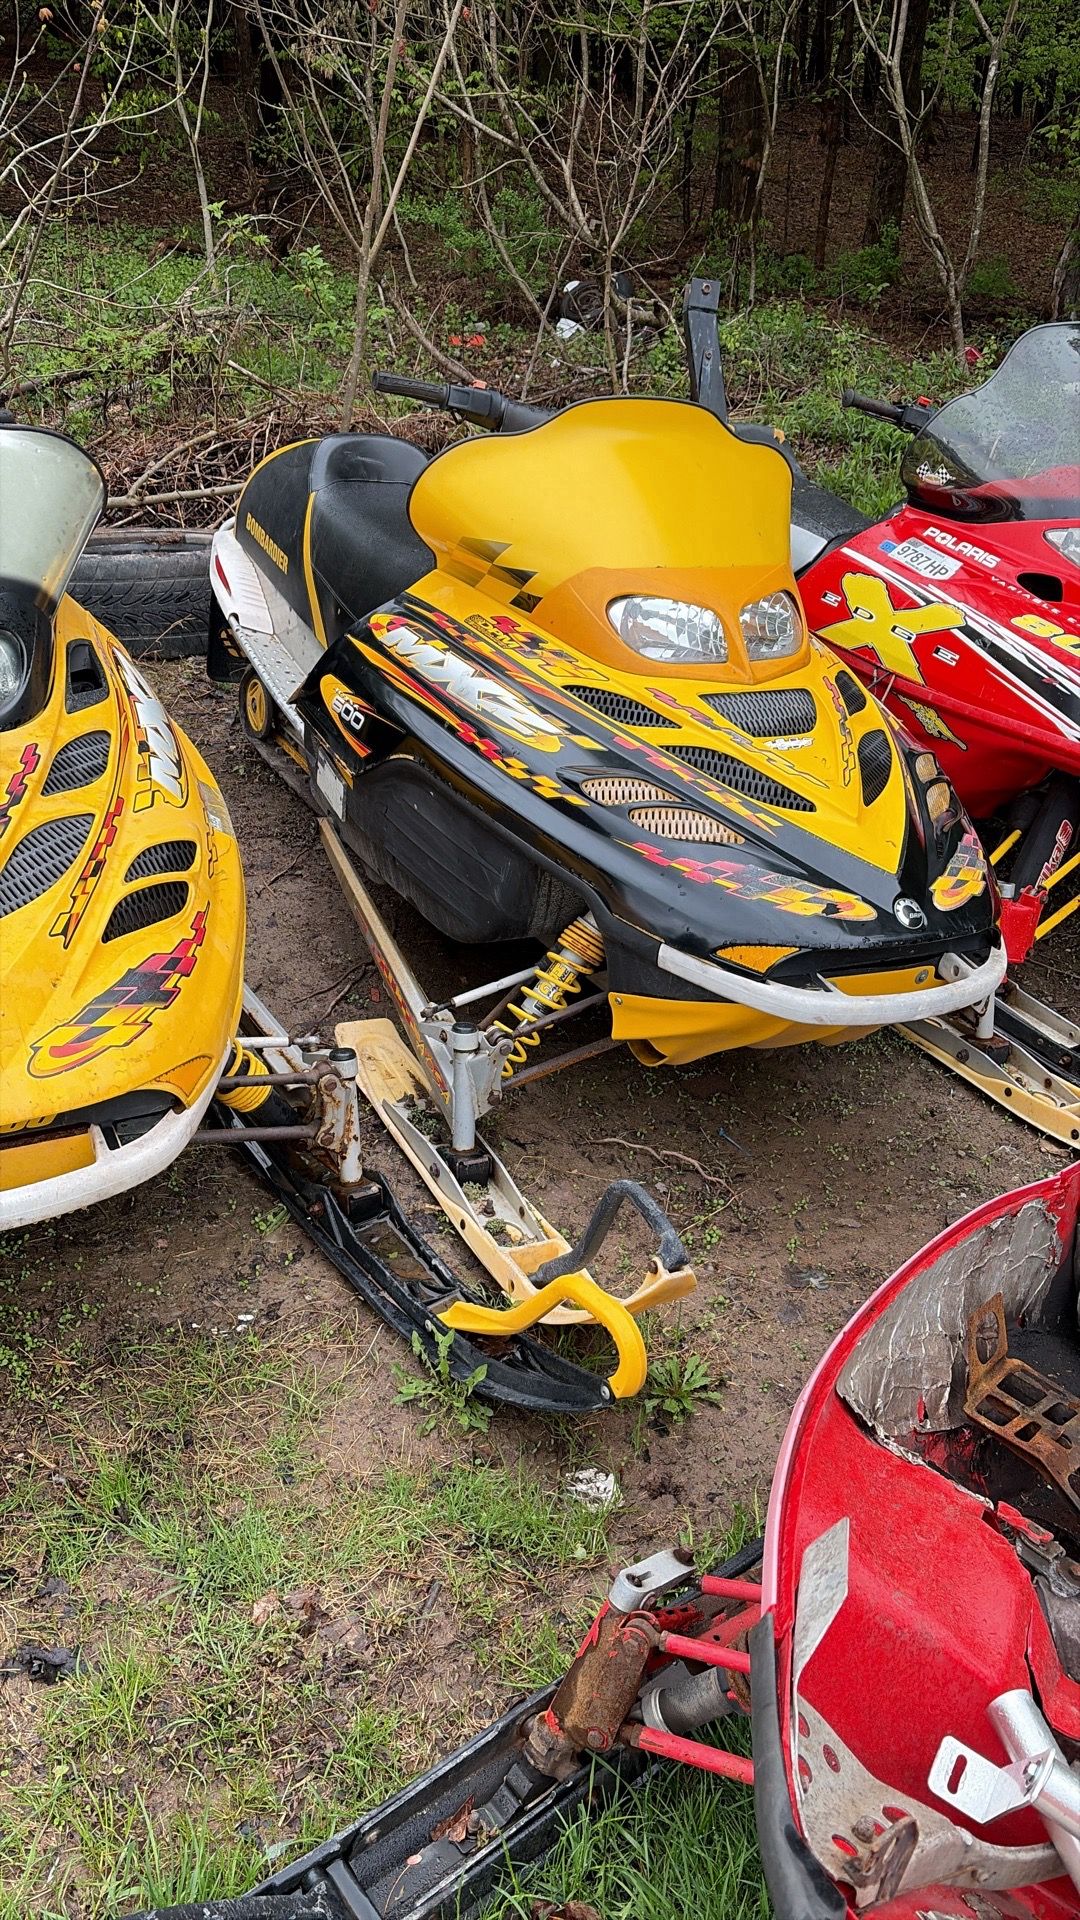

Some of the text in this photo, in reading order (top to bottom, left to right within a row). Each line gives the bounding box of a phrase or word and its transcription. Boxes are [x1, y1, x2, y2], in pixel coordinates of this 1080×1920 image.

[245, 512, 289, 575] BOMBARDIER
[922, 526, 1002, 569] POLARIS
[991, 575, 1062, 615] VARIABLE
[479, 618, 522, 649] DPM
[380, 625, 565, 737] MXZ
